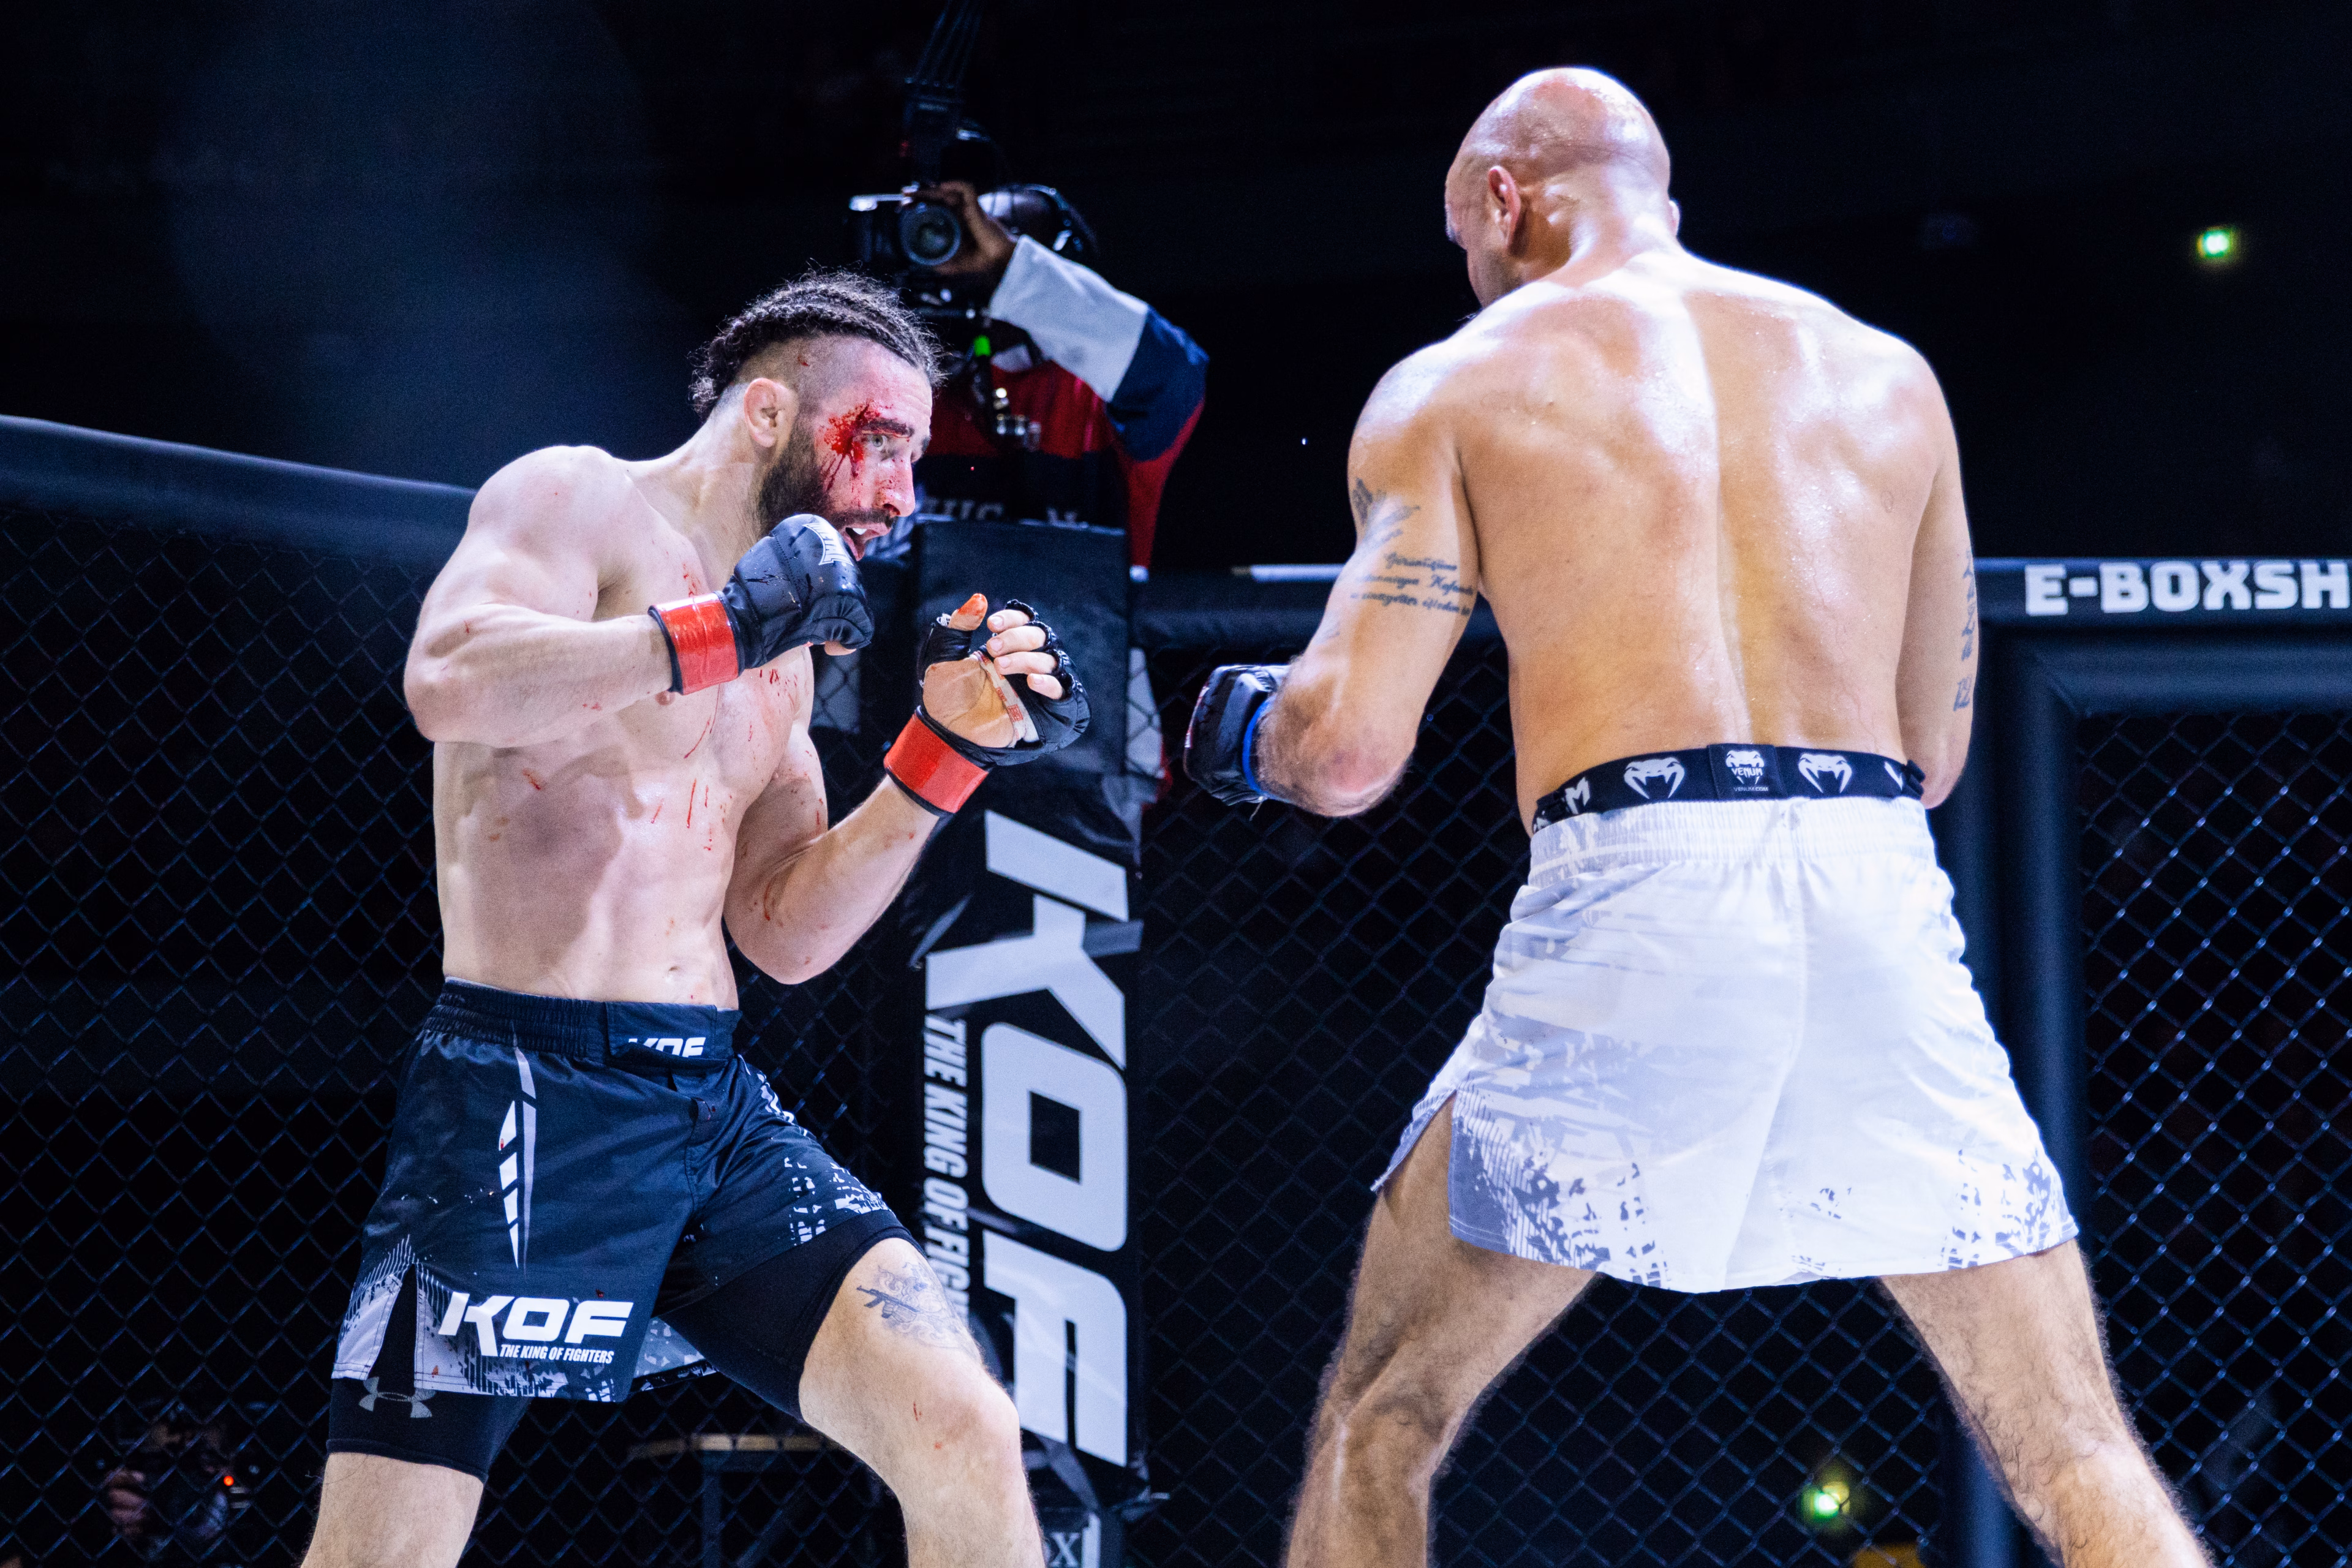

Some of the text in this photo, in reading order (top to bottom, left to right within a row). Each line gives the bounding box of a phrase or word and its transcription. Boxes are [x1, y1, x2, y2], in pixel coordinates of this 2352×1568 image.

[1731, 767, 1763, 778] VENUM
[925, 1017, 968, 1088] THE
[924, 1082, 968, 1182] KING
[925, 809, 1129, 1468] KOF
[924, 1177, 968, 1235] OF
[438, 1291, 633, 1357] KOF
[500, 1343, 614, 1364] THE KING OF FIGHTERS
